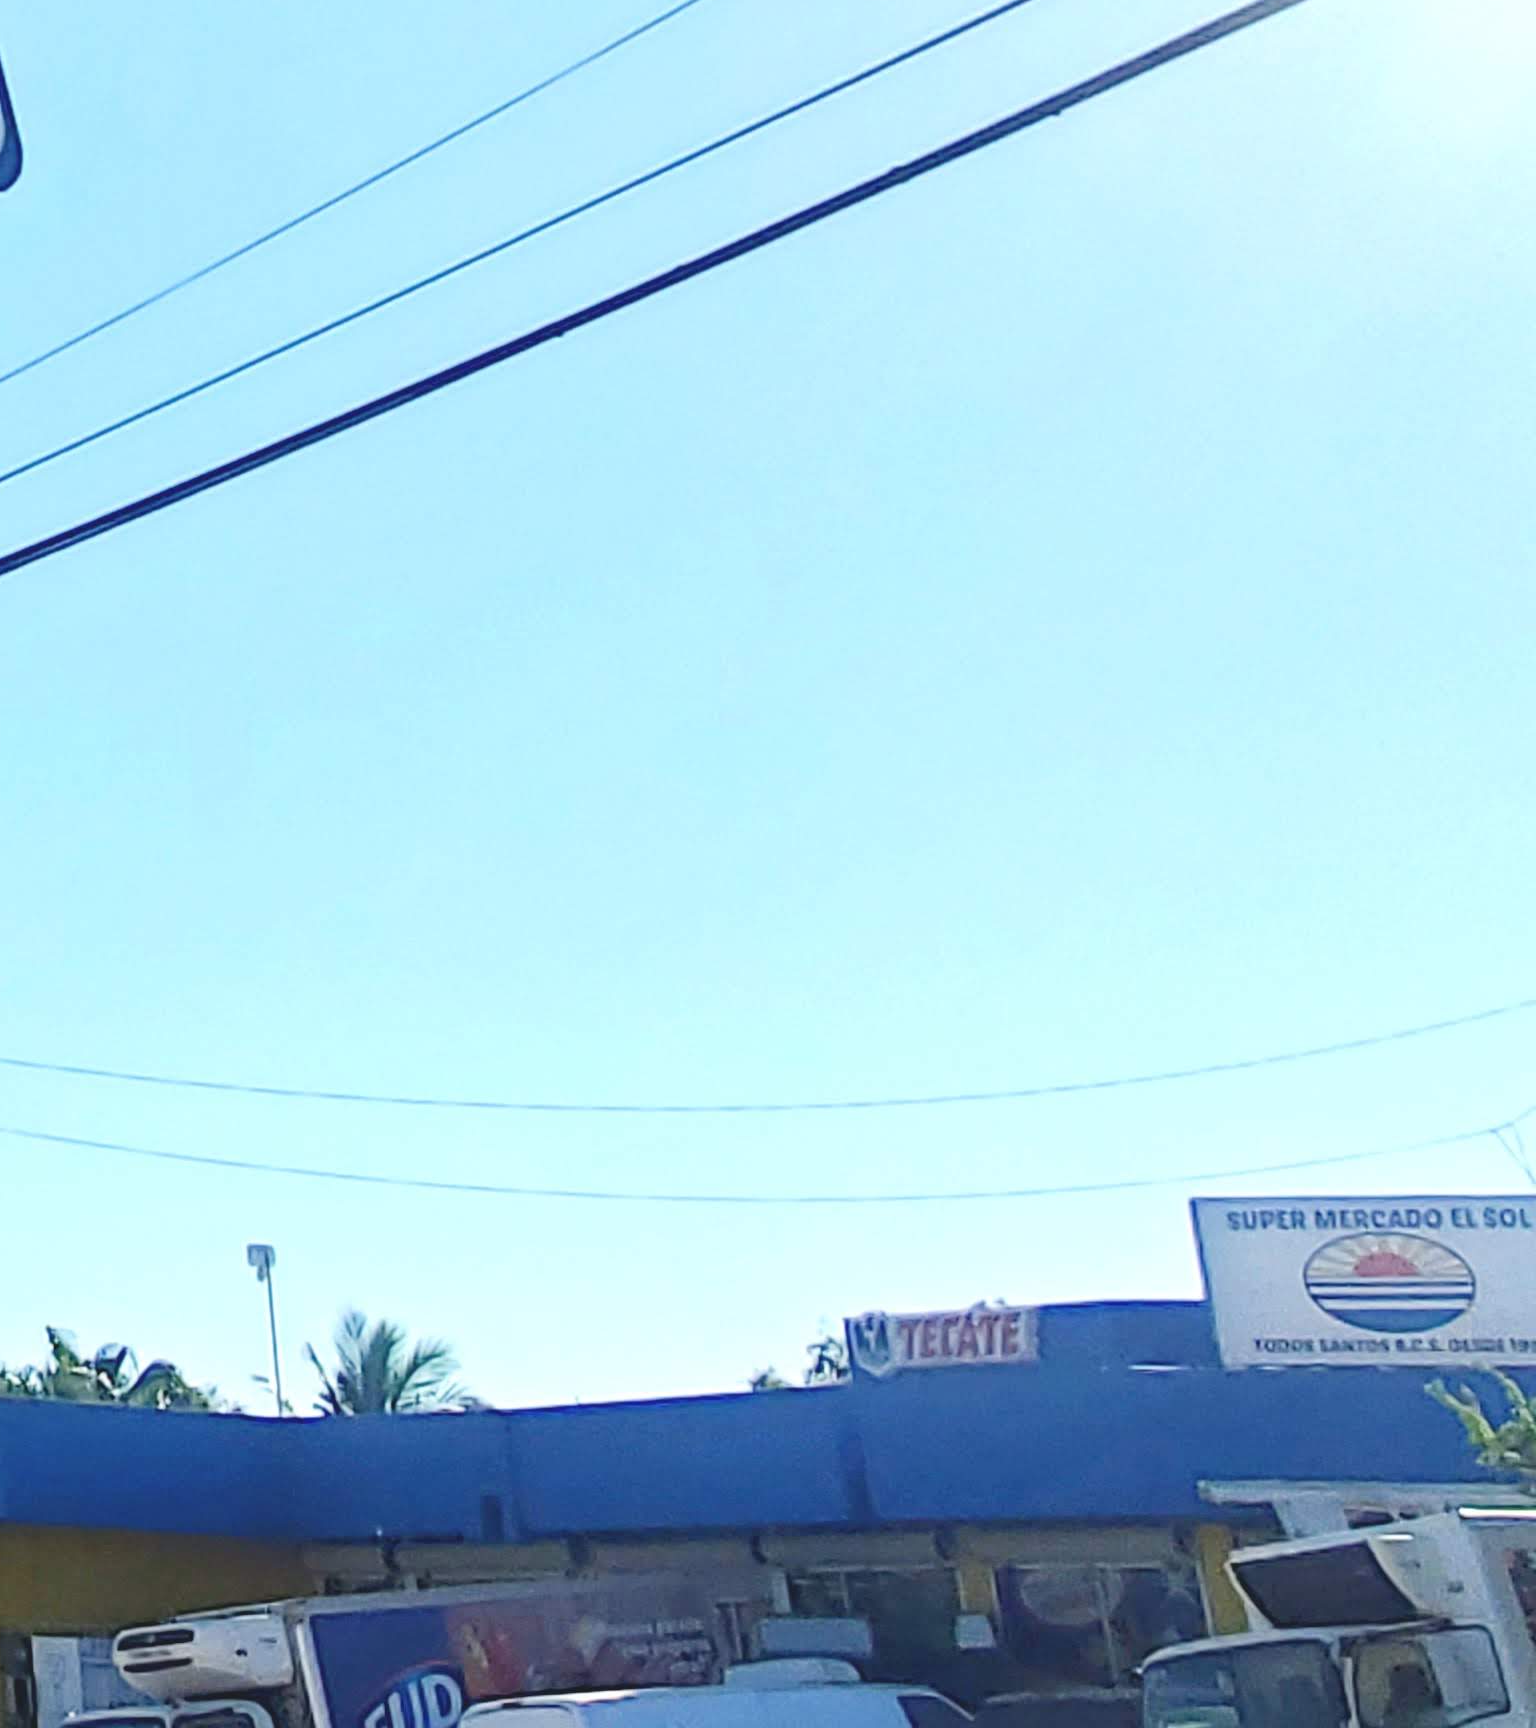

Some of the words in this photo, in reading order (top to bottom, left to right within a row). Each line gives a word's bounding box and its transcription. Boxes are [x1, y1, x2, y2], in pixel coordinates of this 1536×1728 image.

[1226, 1209, 1307, 1232] SUPER
[1313, 1207, 1444, 1231] MERCADO
[1450, 1207, 1477, 1229] EL
[1481, 1206, 1532, 1229] SOL
[897, 1312, 1023, 1361] TECATE
